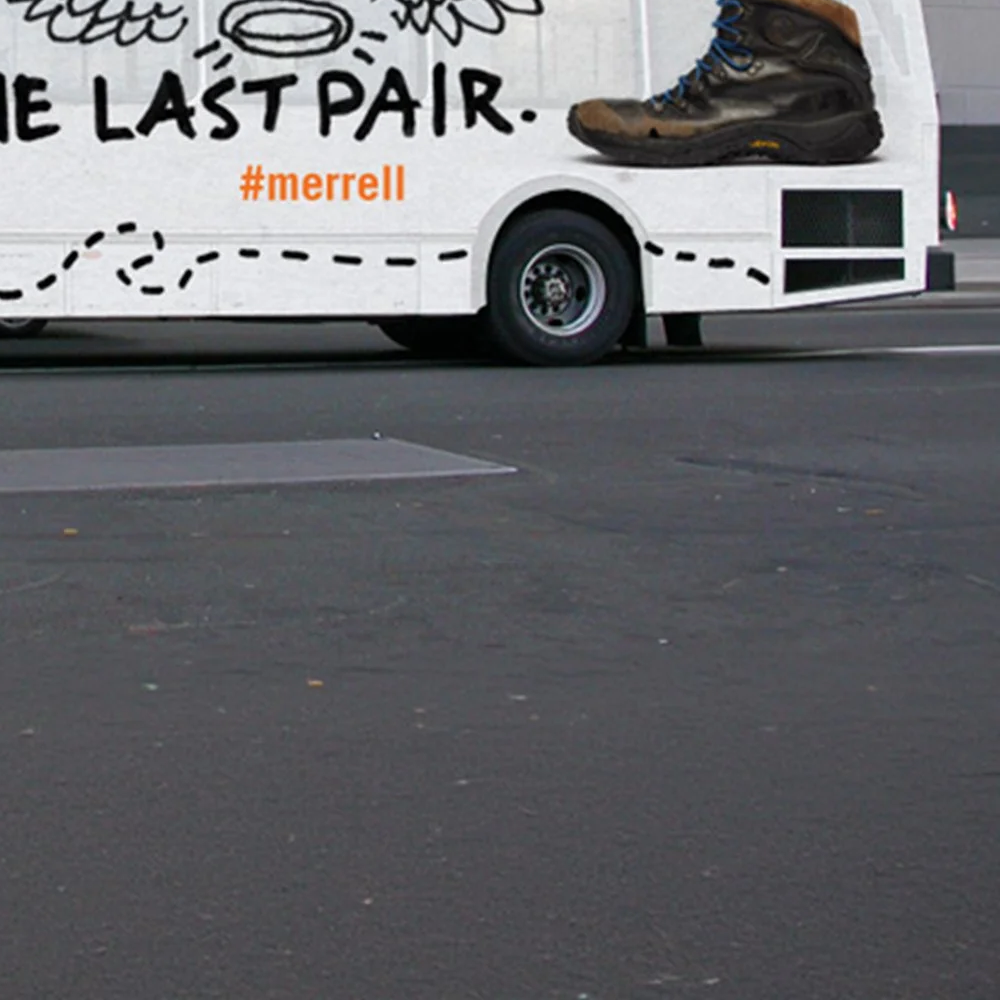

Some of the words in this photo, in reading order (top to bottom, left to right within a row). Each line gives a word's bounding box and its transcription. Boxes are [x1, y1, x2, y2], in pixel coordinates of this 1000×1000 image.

[93, 70, 299, 142] LAST
[318, 61, 538, 142] PAIR.
[239, 164, 405, 202] #merrell
